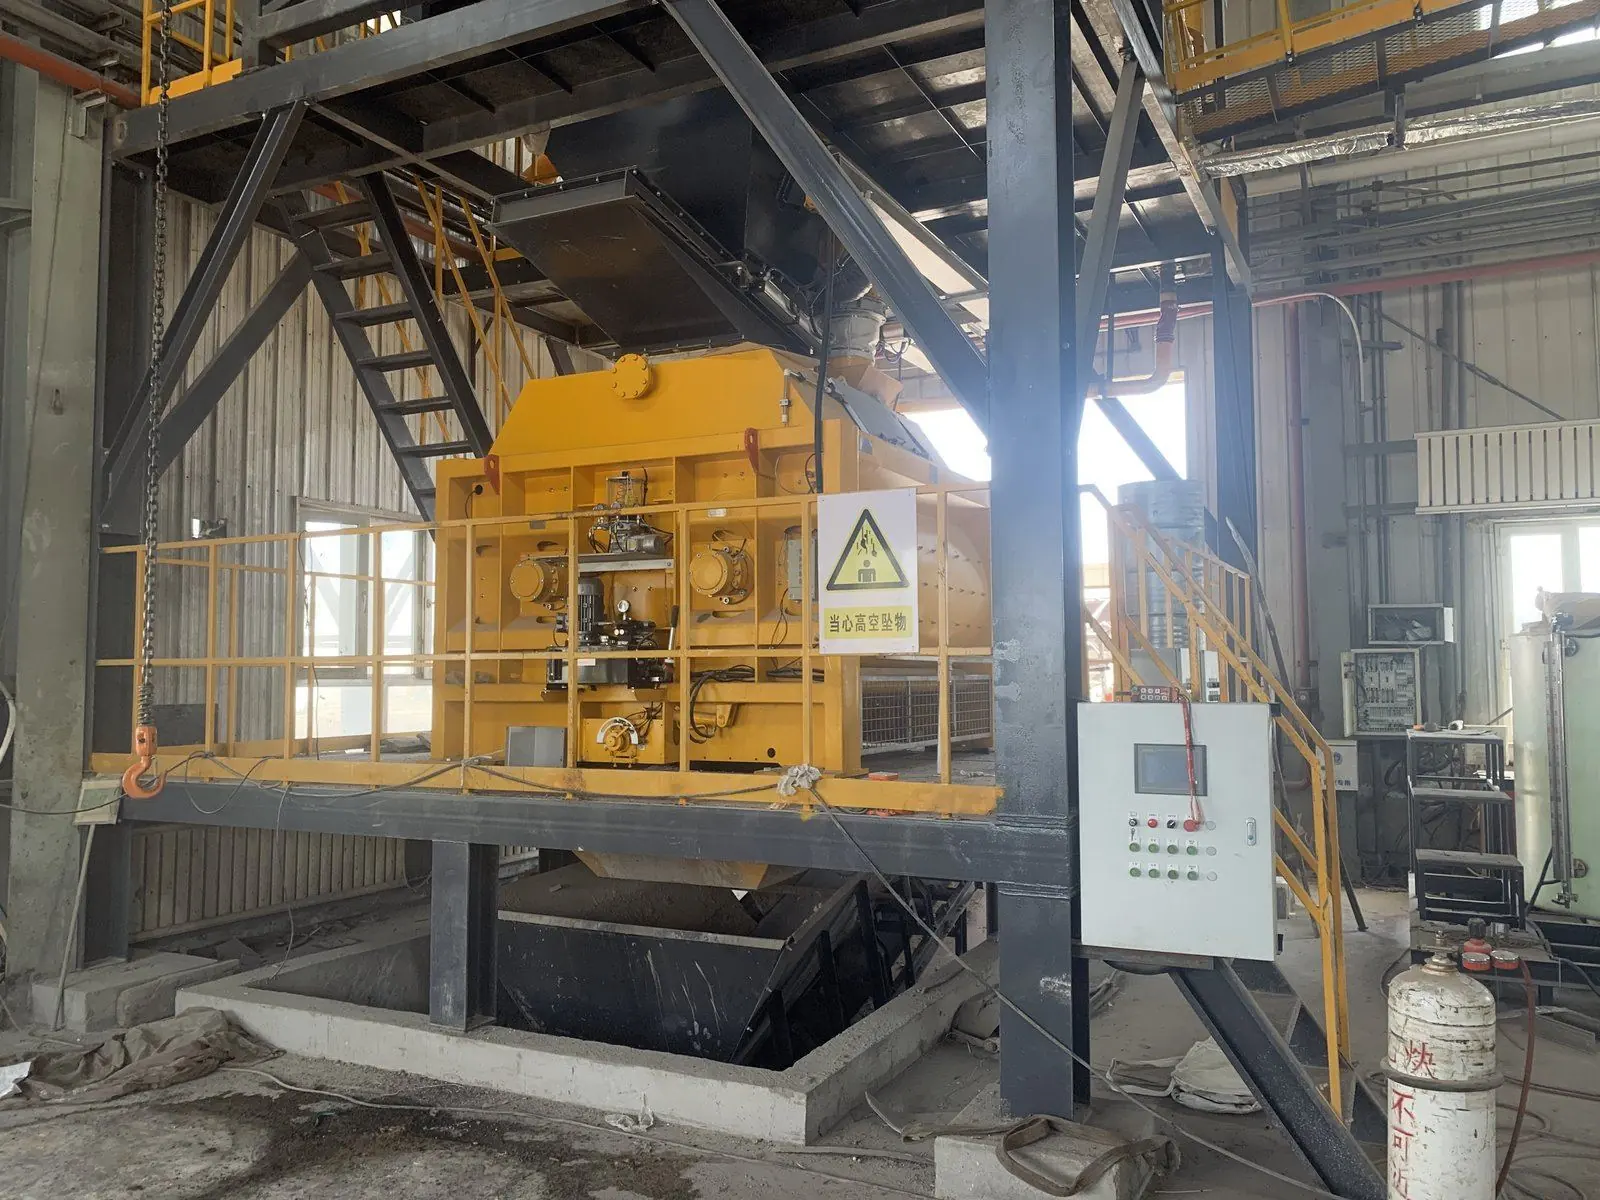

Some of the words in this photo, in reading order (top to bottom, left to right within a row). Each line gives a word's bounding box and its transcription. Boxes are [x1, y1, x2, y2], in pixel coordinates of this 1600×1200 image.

[829, 611, 907, 633] 当心高空坠物
